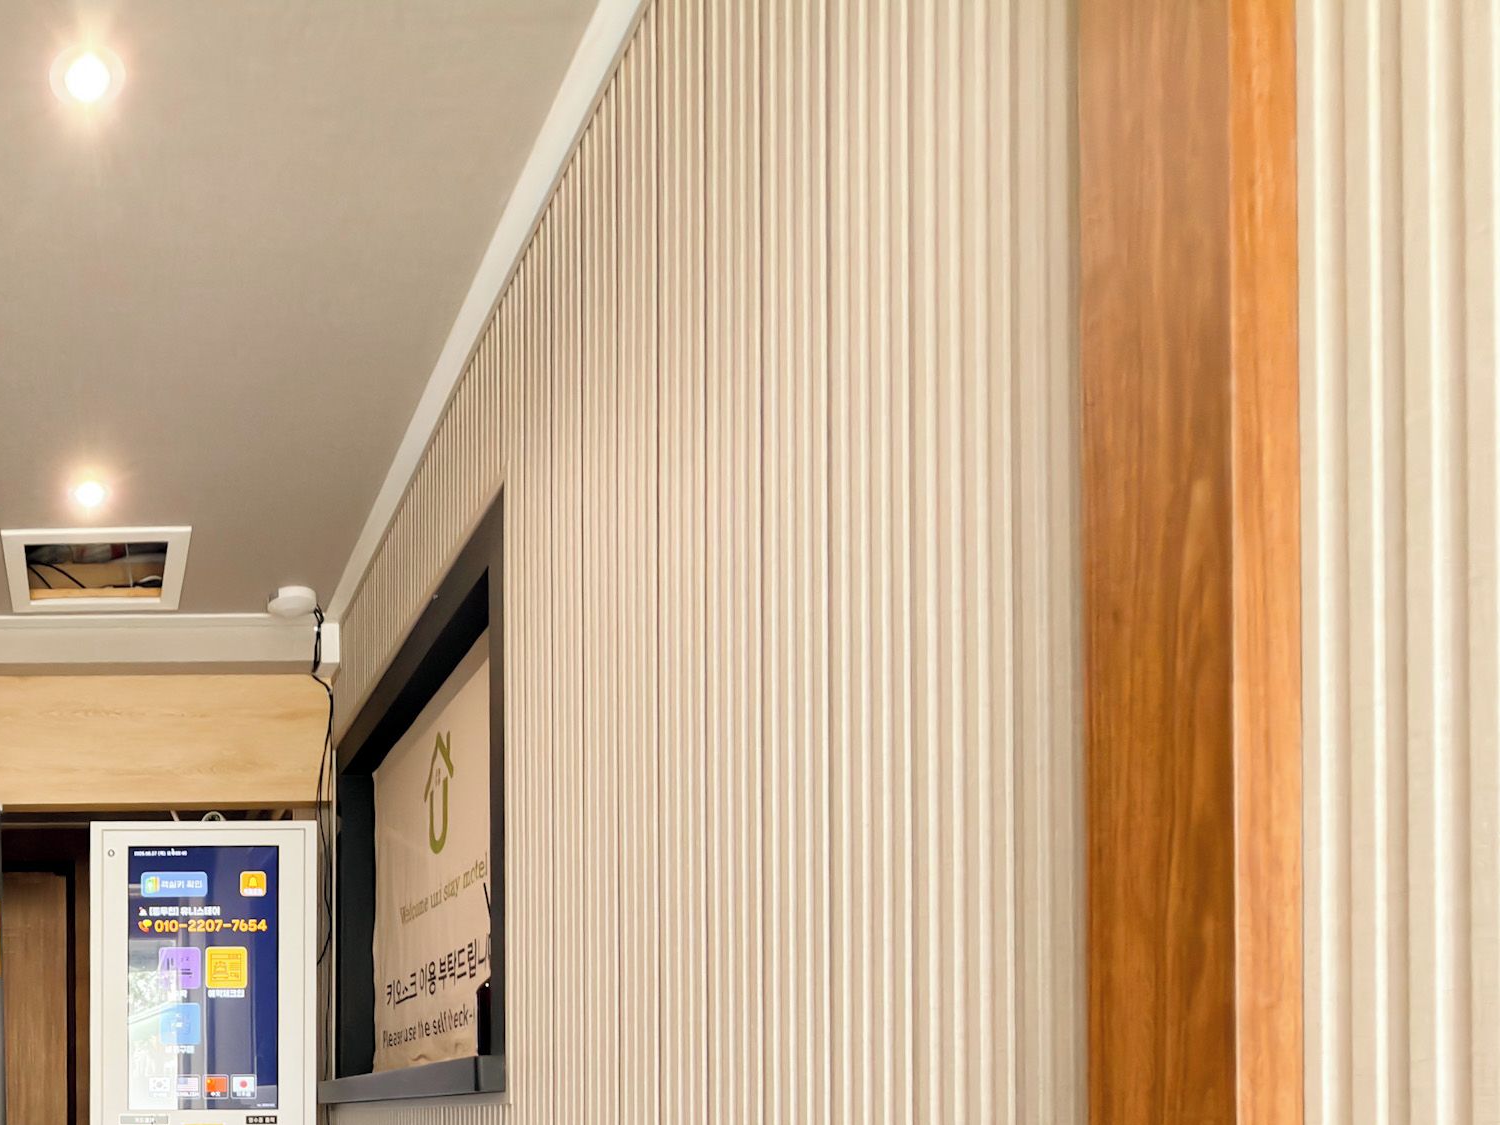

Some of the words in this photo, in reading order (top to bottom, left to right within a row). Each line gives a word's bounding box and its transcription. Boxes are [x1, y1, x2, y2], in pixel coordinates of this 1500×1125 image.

[154, 918, 268, 933] 010-2207-7654
[386, 971, 418, 1010] 키오스크
[419, 960, 437, 997] 이용
